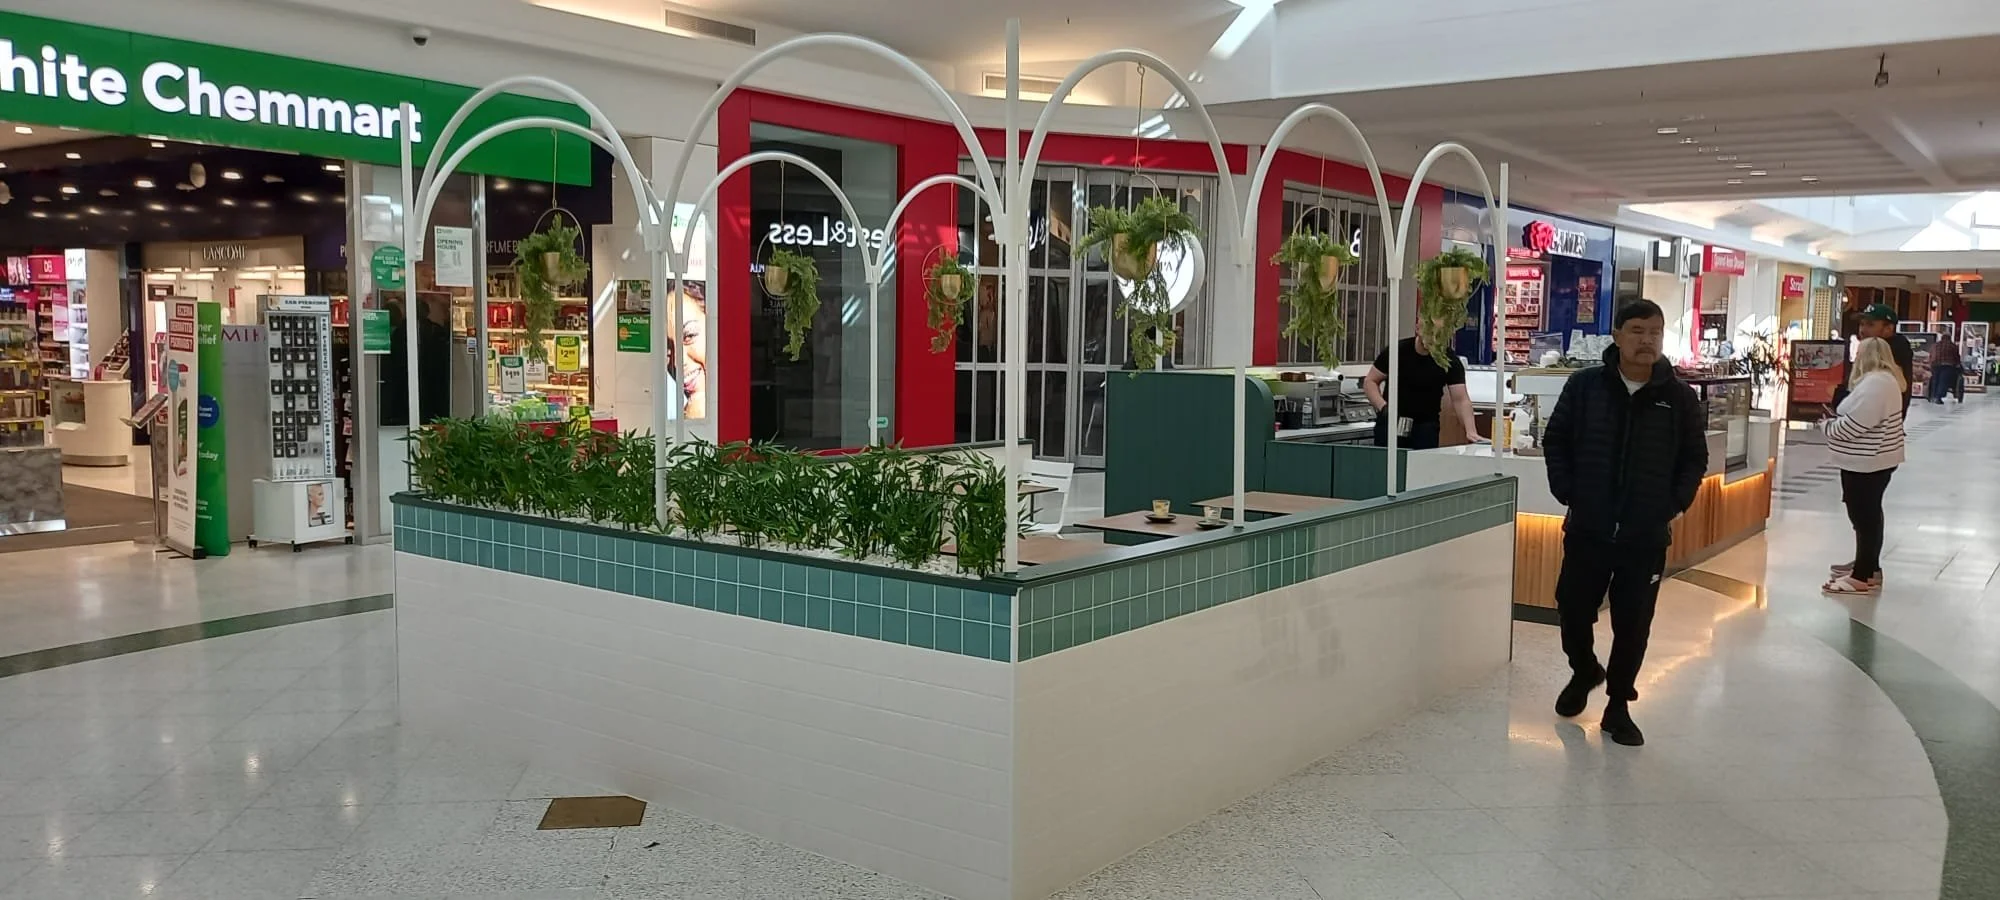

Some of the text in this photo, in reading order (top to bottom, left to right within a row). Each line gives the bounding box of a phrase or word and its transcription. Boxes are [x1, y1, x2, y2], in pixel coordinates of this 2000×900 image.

[142, 62, 422, 143] Chemmart
[437, 238, 463, 246] OPENING
[618, 316, 649, 325] Shop Online
[1795, 370, 1809, 378] BE
